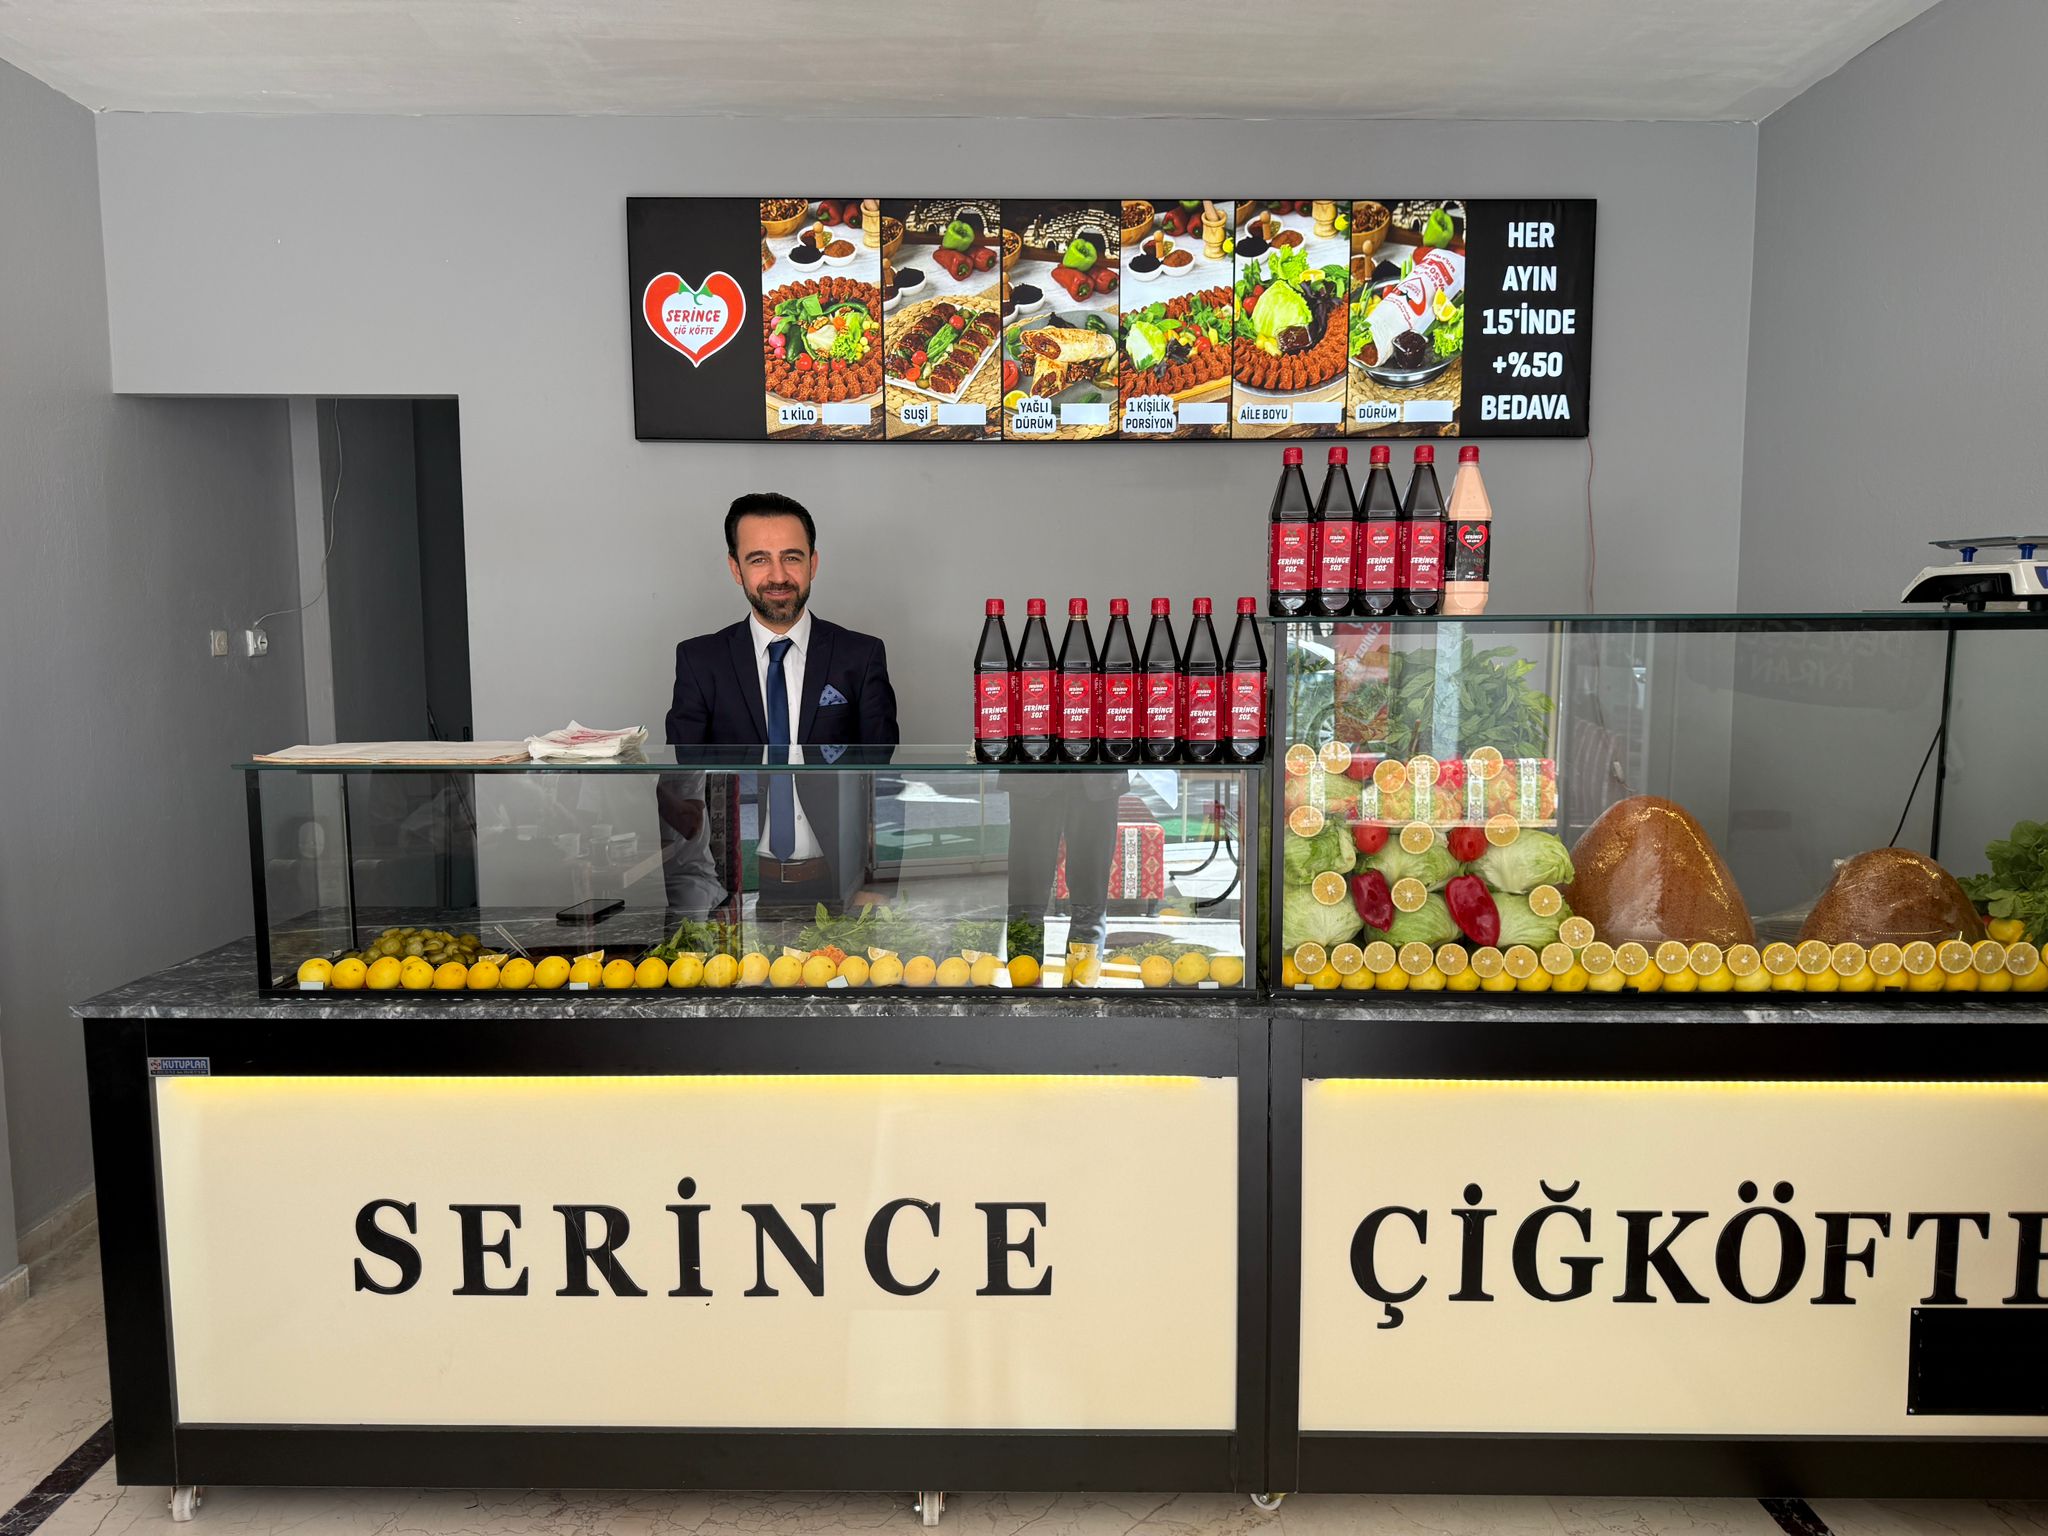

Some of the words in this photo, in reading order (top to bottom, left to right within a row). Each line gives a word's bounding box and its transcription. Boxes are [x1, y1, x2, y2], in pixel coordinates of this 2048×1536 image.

[1508, 222, 1555, 248] HER
[1502, 266, 1557, 291] AYIN
[666, 307, 721, 323] SERİNCE
[1482, 302, 1576, 335] 15'İNDE
[689, 325, 714, 335] KÖFTE
[1492, 351, 1563, 378] +%50
[1020, 400, 1049, 413] YAĞLI
[1129, 401, 1135, 412] 1
[1137, 399, 1170, 415] KİŞİLİK
[1481, 394, 1570, 420] BEDAVA
[782, 409, 789, 420] 1
[791, 406, 814, 421] KİLO
[904, 406, 928, 422] SUŞİ
[1240, 407, 1261, 420] AİLE
[1263, 408, 1288, 420] BOYU
[1359, 405, 1397, 418] DÜRÜM
[1015, 415, 1053, 429] DÜRÜM
[1126, 415, 1173, 429] PORSİYON
[1277, 557, 1304, 565] SERİNCE
[1322, 556, 1350, 564] SERİNCE
[1367, 556, 1394, 564] SERİNCE
[1410, 556, 1438, 564] SERİNCE
[1374, 564, 1387, 572] SOS
[1417, 564, 1430, 572] SOS
[981, 706, 1007, 715] SERİNCE
[1024, 704, 1050, 712] SERİNCE
[1063, 707, 1090, 715] SERİNCE
[1107, 707, 1133, 715] SERİNCE
[1147, 706, 1174, 714] SERİNCE
[1231, 705, 1258, 713] SERİNCE
[1031, 711, 1043, 719] SOS
[1190, 709, 1216, 717] SERİNCE
[1070, 714, 1083, 722] SOS
[1114, 714, 1126, 722] SOS
[162, 1060, 207, 1069] KUTUPLAR
[354, 1176, 1053, 1297] SERİNCE
